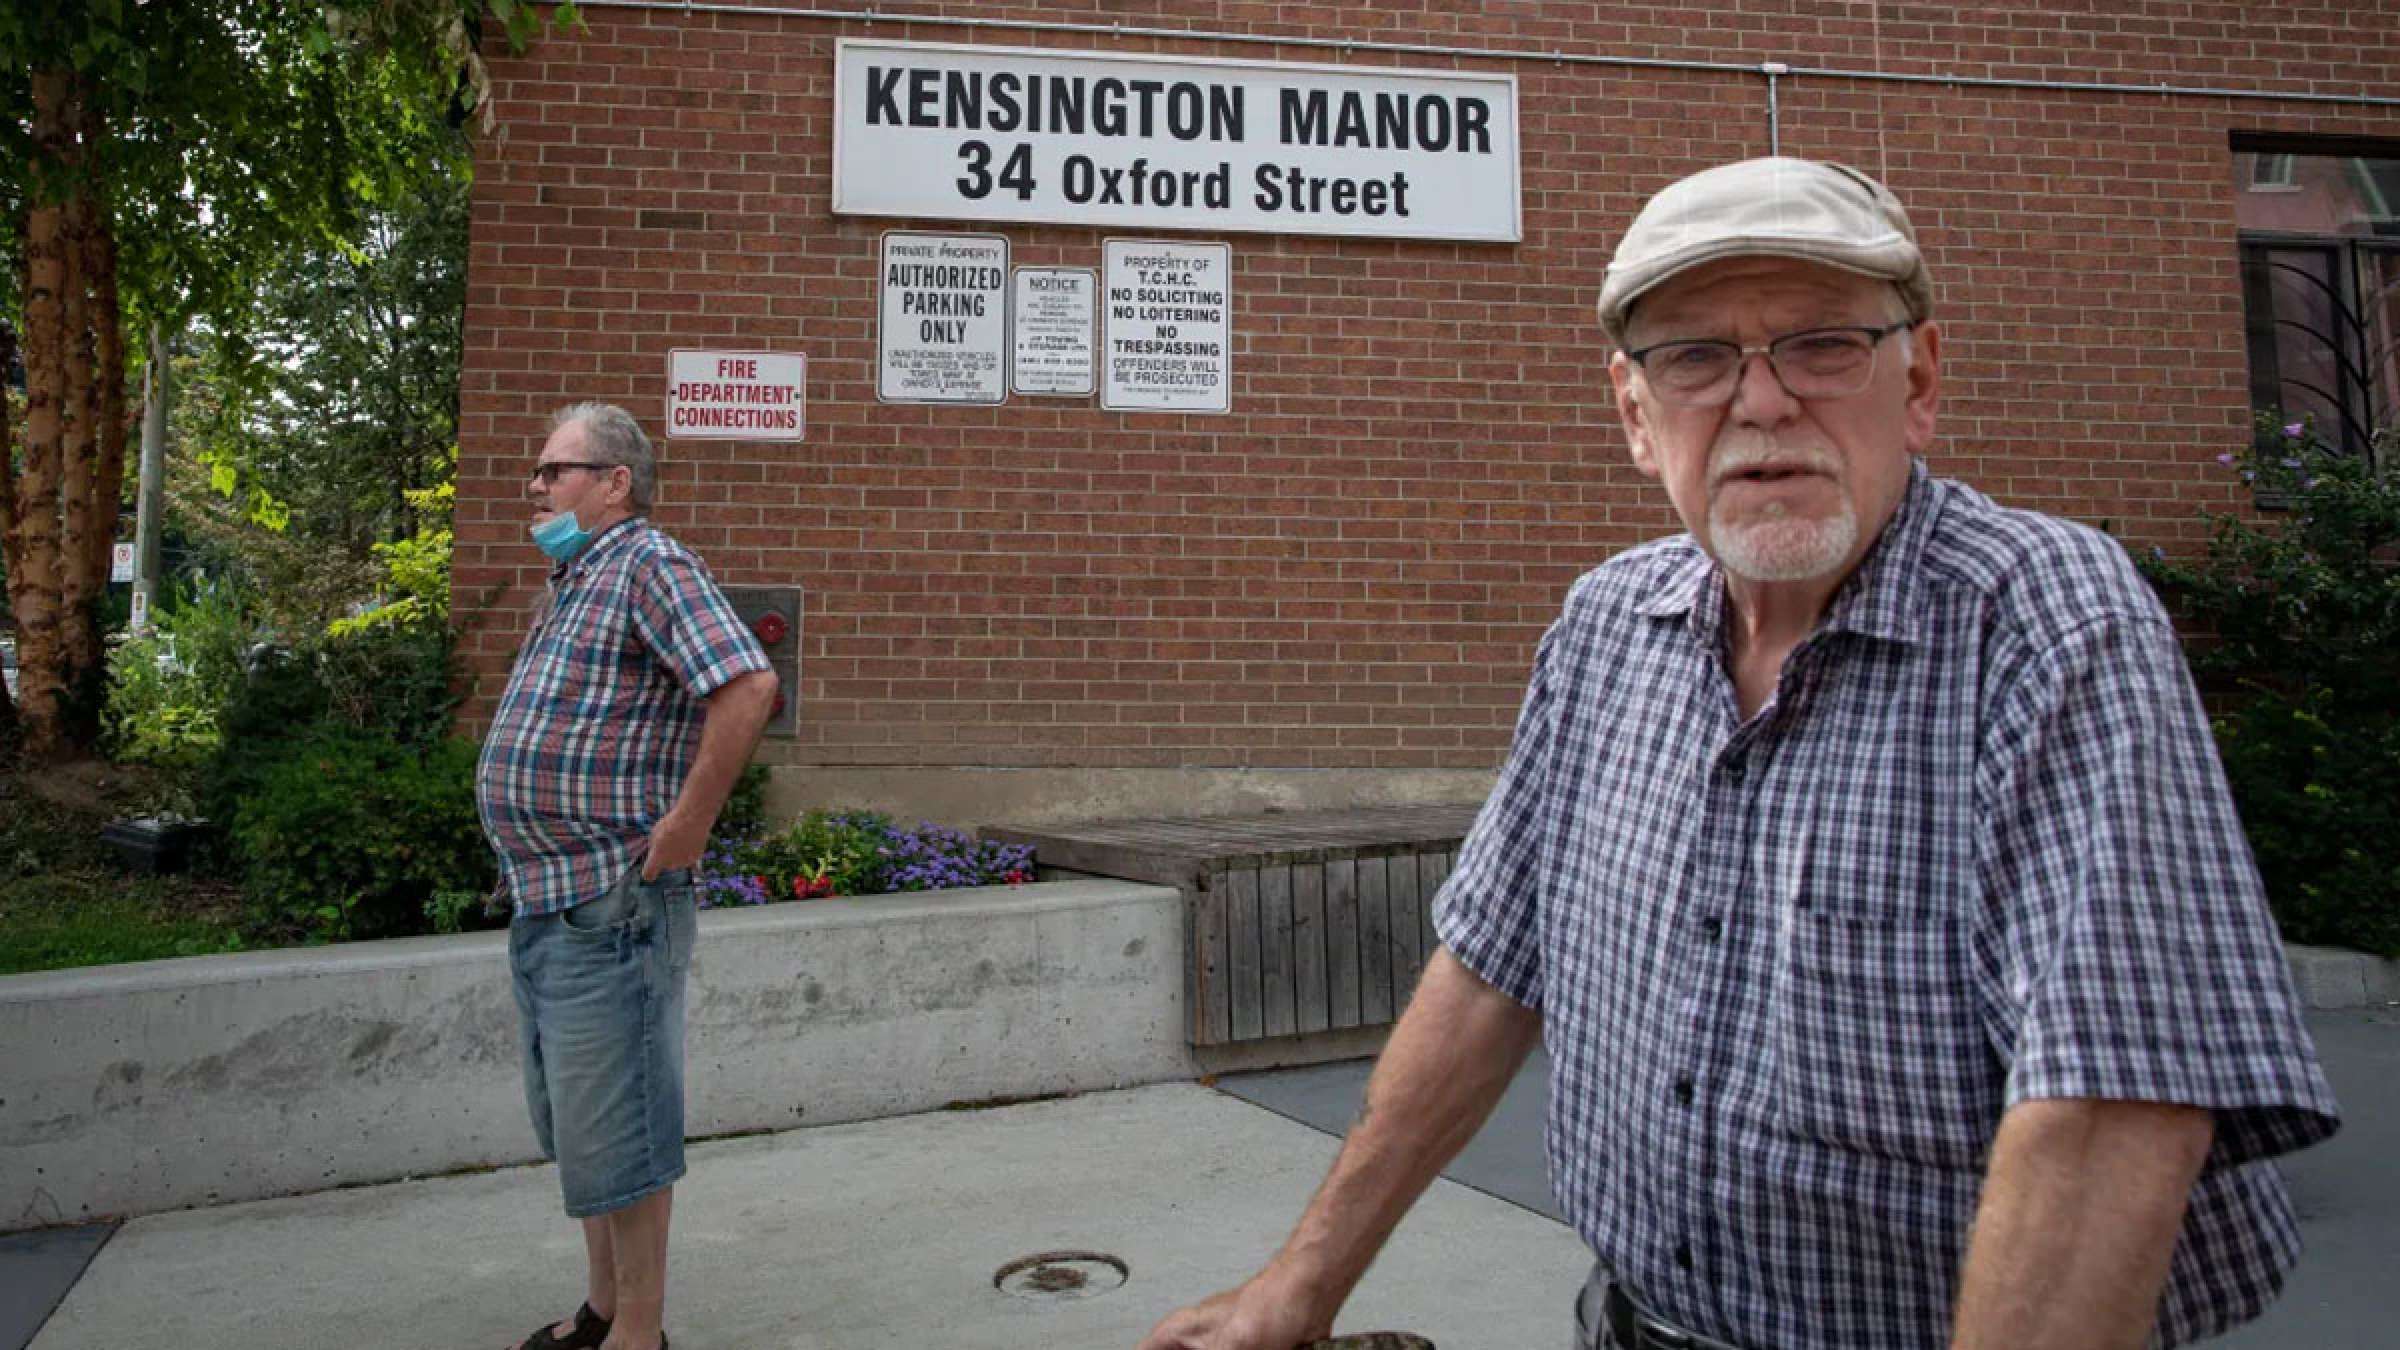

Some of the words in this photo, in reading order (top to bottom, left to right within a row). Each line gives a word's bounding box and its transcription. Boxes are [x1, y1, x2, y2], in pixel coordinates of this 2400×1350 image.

[865, 65, 1245, 142] KENSINGTON
[1281, 88, 1493, 154] MANOR
[956, 139, 1037, 201] 34
[1062, 154, 1230, 210] Oxford
[1254, 164, 1410, 218] Street
[939, 247, 1000, 260] PROPERTY
[1123, 255, 1190, 269] PROPERTY
[1192, 259, 1210, 271] OF
[888, 263, 1001, 290] AUTHORIZED
[1029, 276, 1080, 291] NOTICE
[1138, 271, 1198, 286] T.C.H.C.
[1111, 288, 1132, 301] NO
[1138, 289, 1222, 304] SOLICITING
[903, 292, 985, 317] PARKING
[1113, 306, 1134, 319] NO
[1140, 307, 1220, 322] LOITERING
[920, 319, 967, 344] ONLY
[1155, 325, 1178, 339] NO
[1114, 340, 1220, 356] TRESPASSING
[718, 359, 757, 379] FIRE
[1113, 357, 1187, 371] OFFENDERS
[1190, 360, 1220, 373] WILL
[1135, 372, 1219, 386] PROSECUTED
[679, 383, 795, 405] DEPARTMENT
[675, 407, 797, 429] CONNECTIONS
